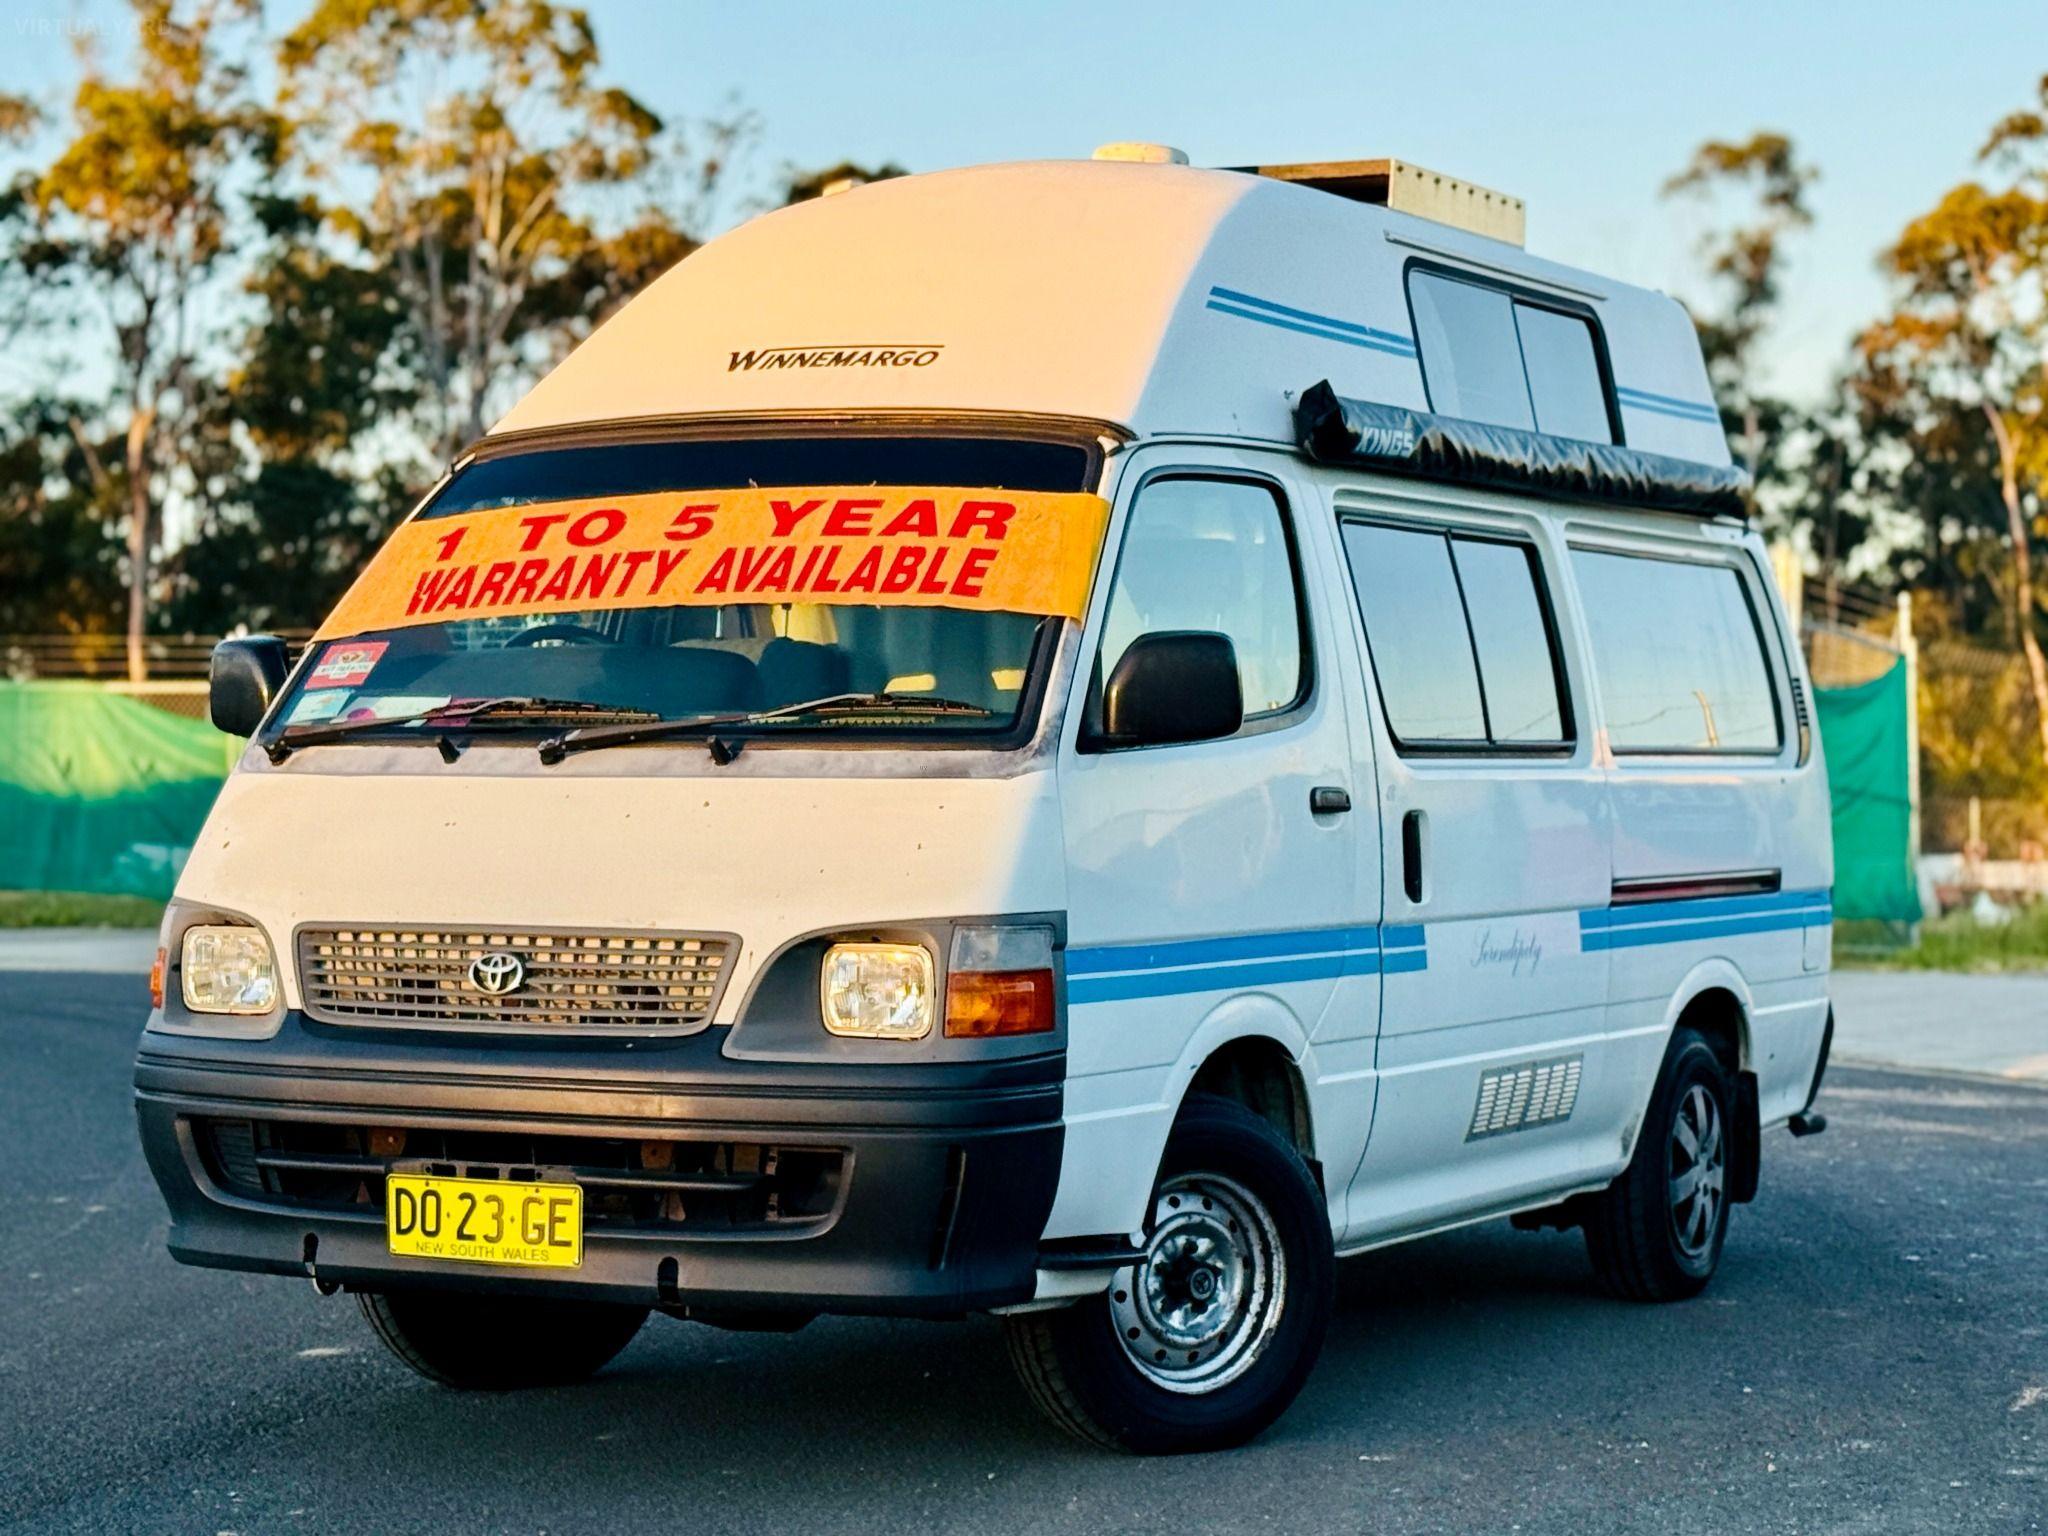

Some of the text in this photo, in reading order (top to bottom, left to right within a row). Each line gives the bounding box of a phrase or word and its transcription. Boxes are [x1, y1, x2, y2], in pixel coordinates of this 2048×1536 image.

[728, 345, 944, 372] WINNEMARGO
[436, 500, 1017, 562] 1 TO 5 YEAR
[405, 545, 1000, 616] WARRANTY AVAILABLE
[416, 1241, 549, 1261] NEW SOUTH WALES
